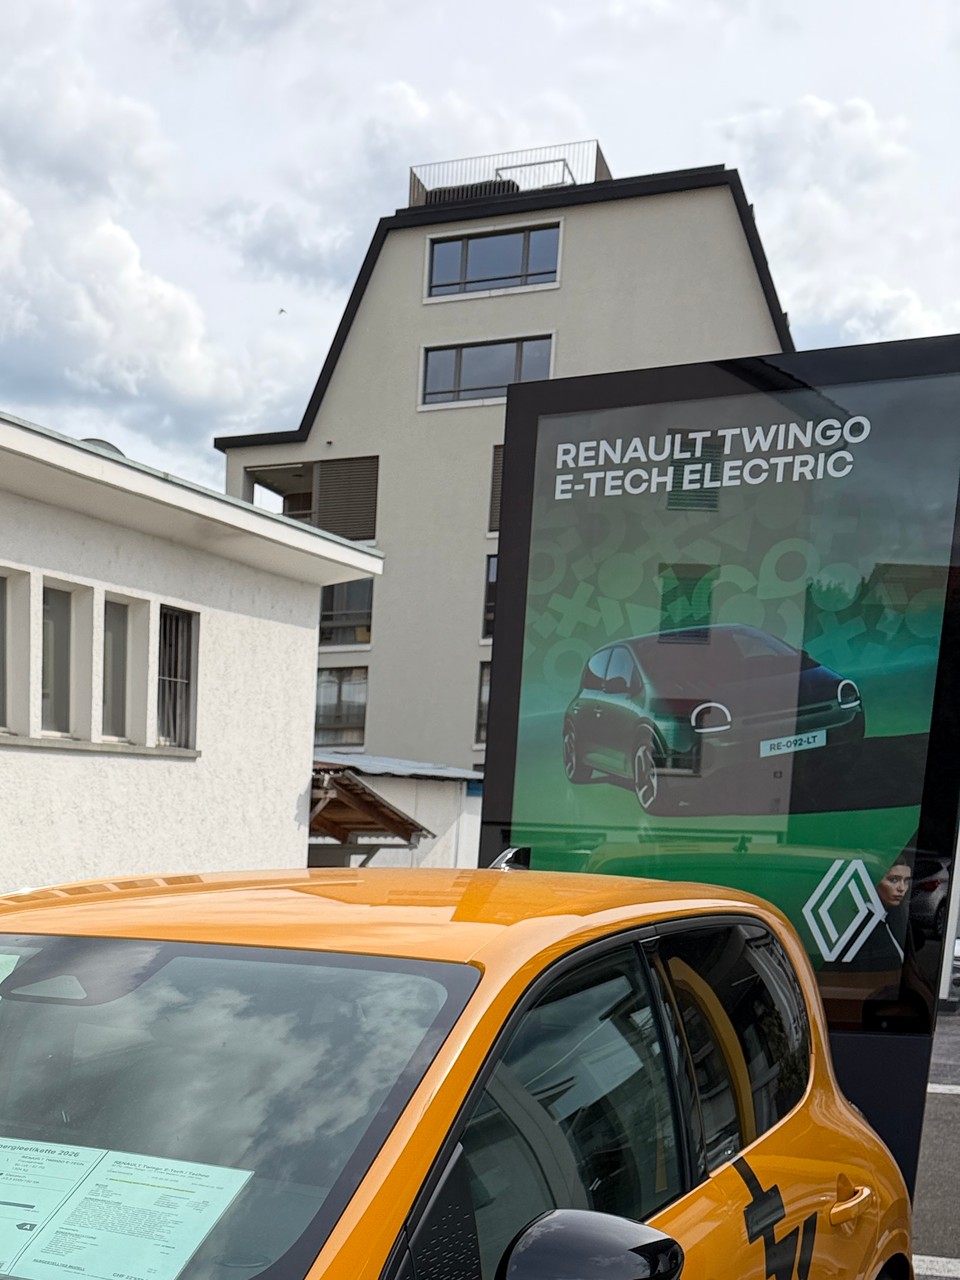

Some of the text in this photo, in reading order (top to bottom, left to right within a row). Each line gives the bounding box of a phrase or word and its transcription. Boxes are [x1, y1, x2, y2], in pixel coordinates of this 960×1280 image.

[555, 415, 872, 469] RENAULT TWINGO
[554, 450, 855, 501] E-TECH ELECTRIC
[769, 735, 818, 752] RE-092-LT
[58, 1149, 80, 1158] 2026
